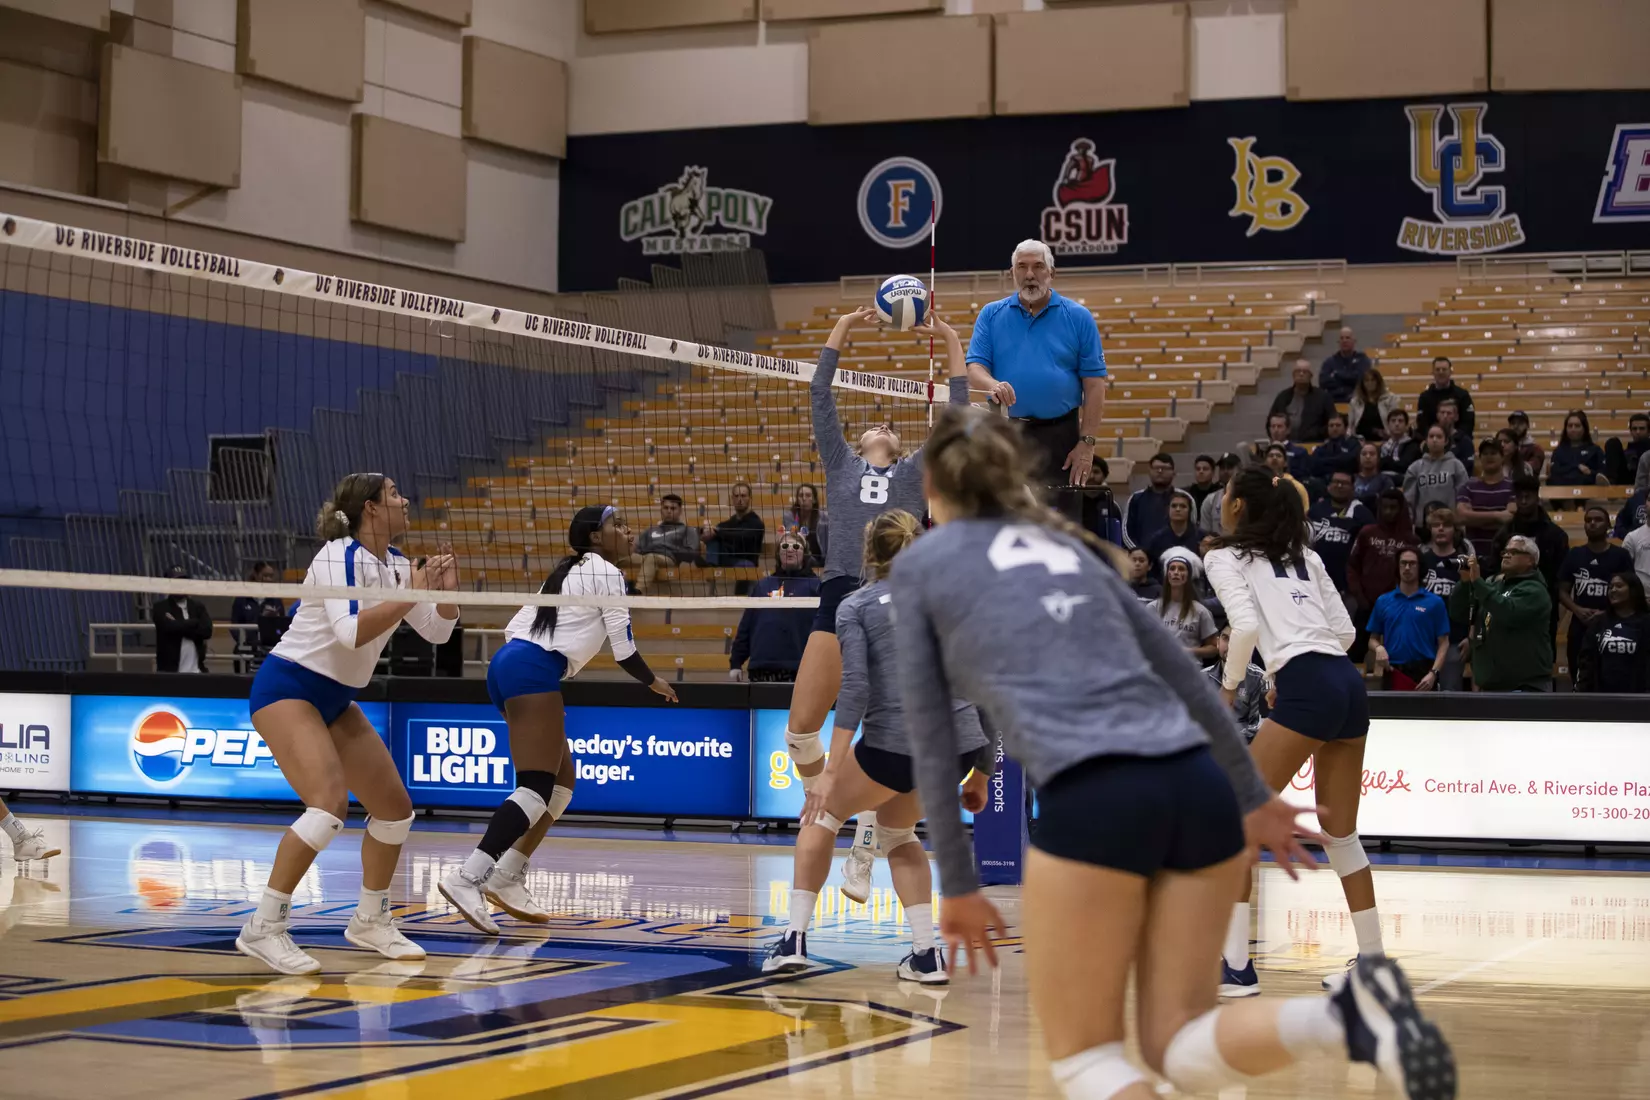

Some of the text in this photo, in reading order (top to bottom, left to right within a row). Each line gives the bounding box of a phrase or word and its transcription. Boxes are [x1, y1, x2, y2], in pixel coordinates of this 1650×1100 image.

[1404, 102, 1505, 222] UC
[622, 190, 772, 237] CAL POLY
[887, 179, 915, 228] F
[1043, 206, 1126, 242] CSUN
[1400, 219, 1523, 251] RIVERSIDE
[56, 226, 240, 277] UC RIVERSIDE VOLLEYBALL
[316, 275, 464, 318] UC RIVERSIDE VOLLEYBALL
[890, 288, 922, 298] molten
[525, 314, 647, 350] UC RIVERSIDE VOLLEYBALL
[698, 344, 799, 375] UC RIVERSIDE VOLLEYBALL
[840, 369, 850, 384] UC
[852, 372, 886, 390] RIVERSIDE
[860, 475, 889, 504] 8
[1418, 473, 1449, 487] CBU
[986, 525, 1081, 575] 4
[1325, 531, 1351, 544] CBU
[1433, 583, 1455, 596] CB
[1608, 641, 1637, 654] CBU
[180, 729, 280, 767] PEP
[427, 727, 496, 755] BUD
[647, 735, 733, 758] favorite
[413, 754, 510, 784] LIGHT
[575, 759, 635, 785] lager.
[1424, 778, 1650, 797] Central Ave. & Riverside Pla
